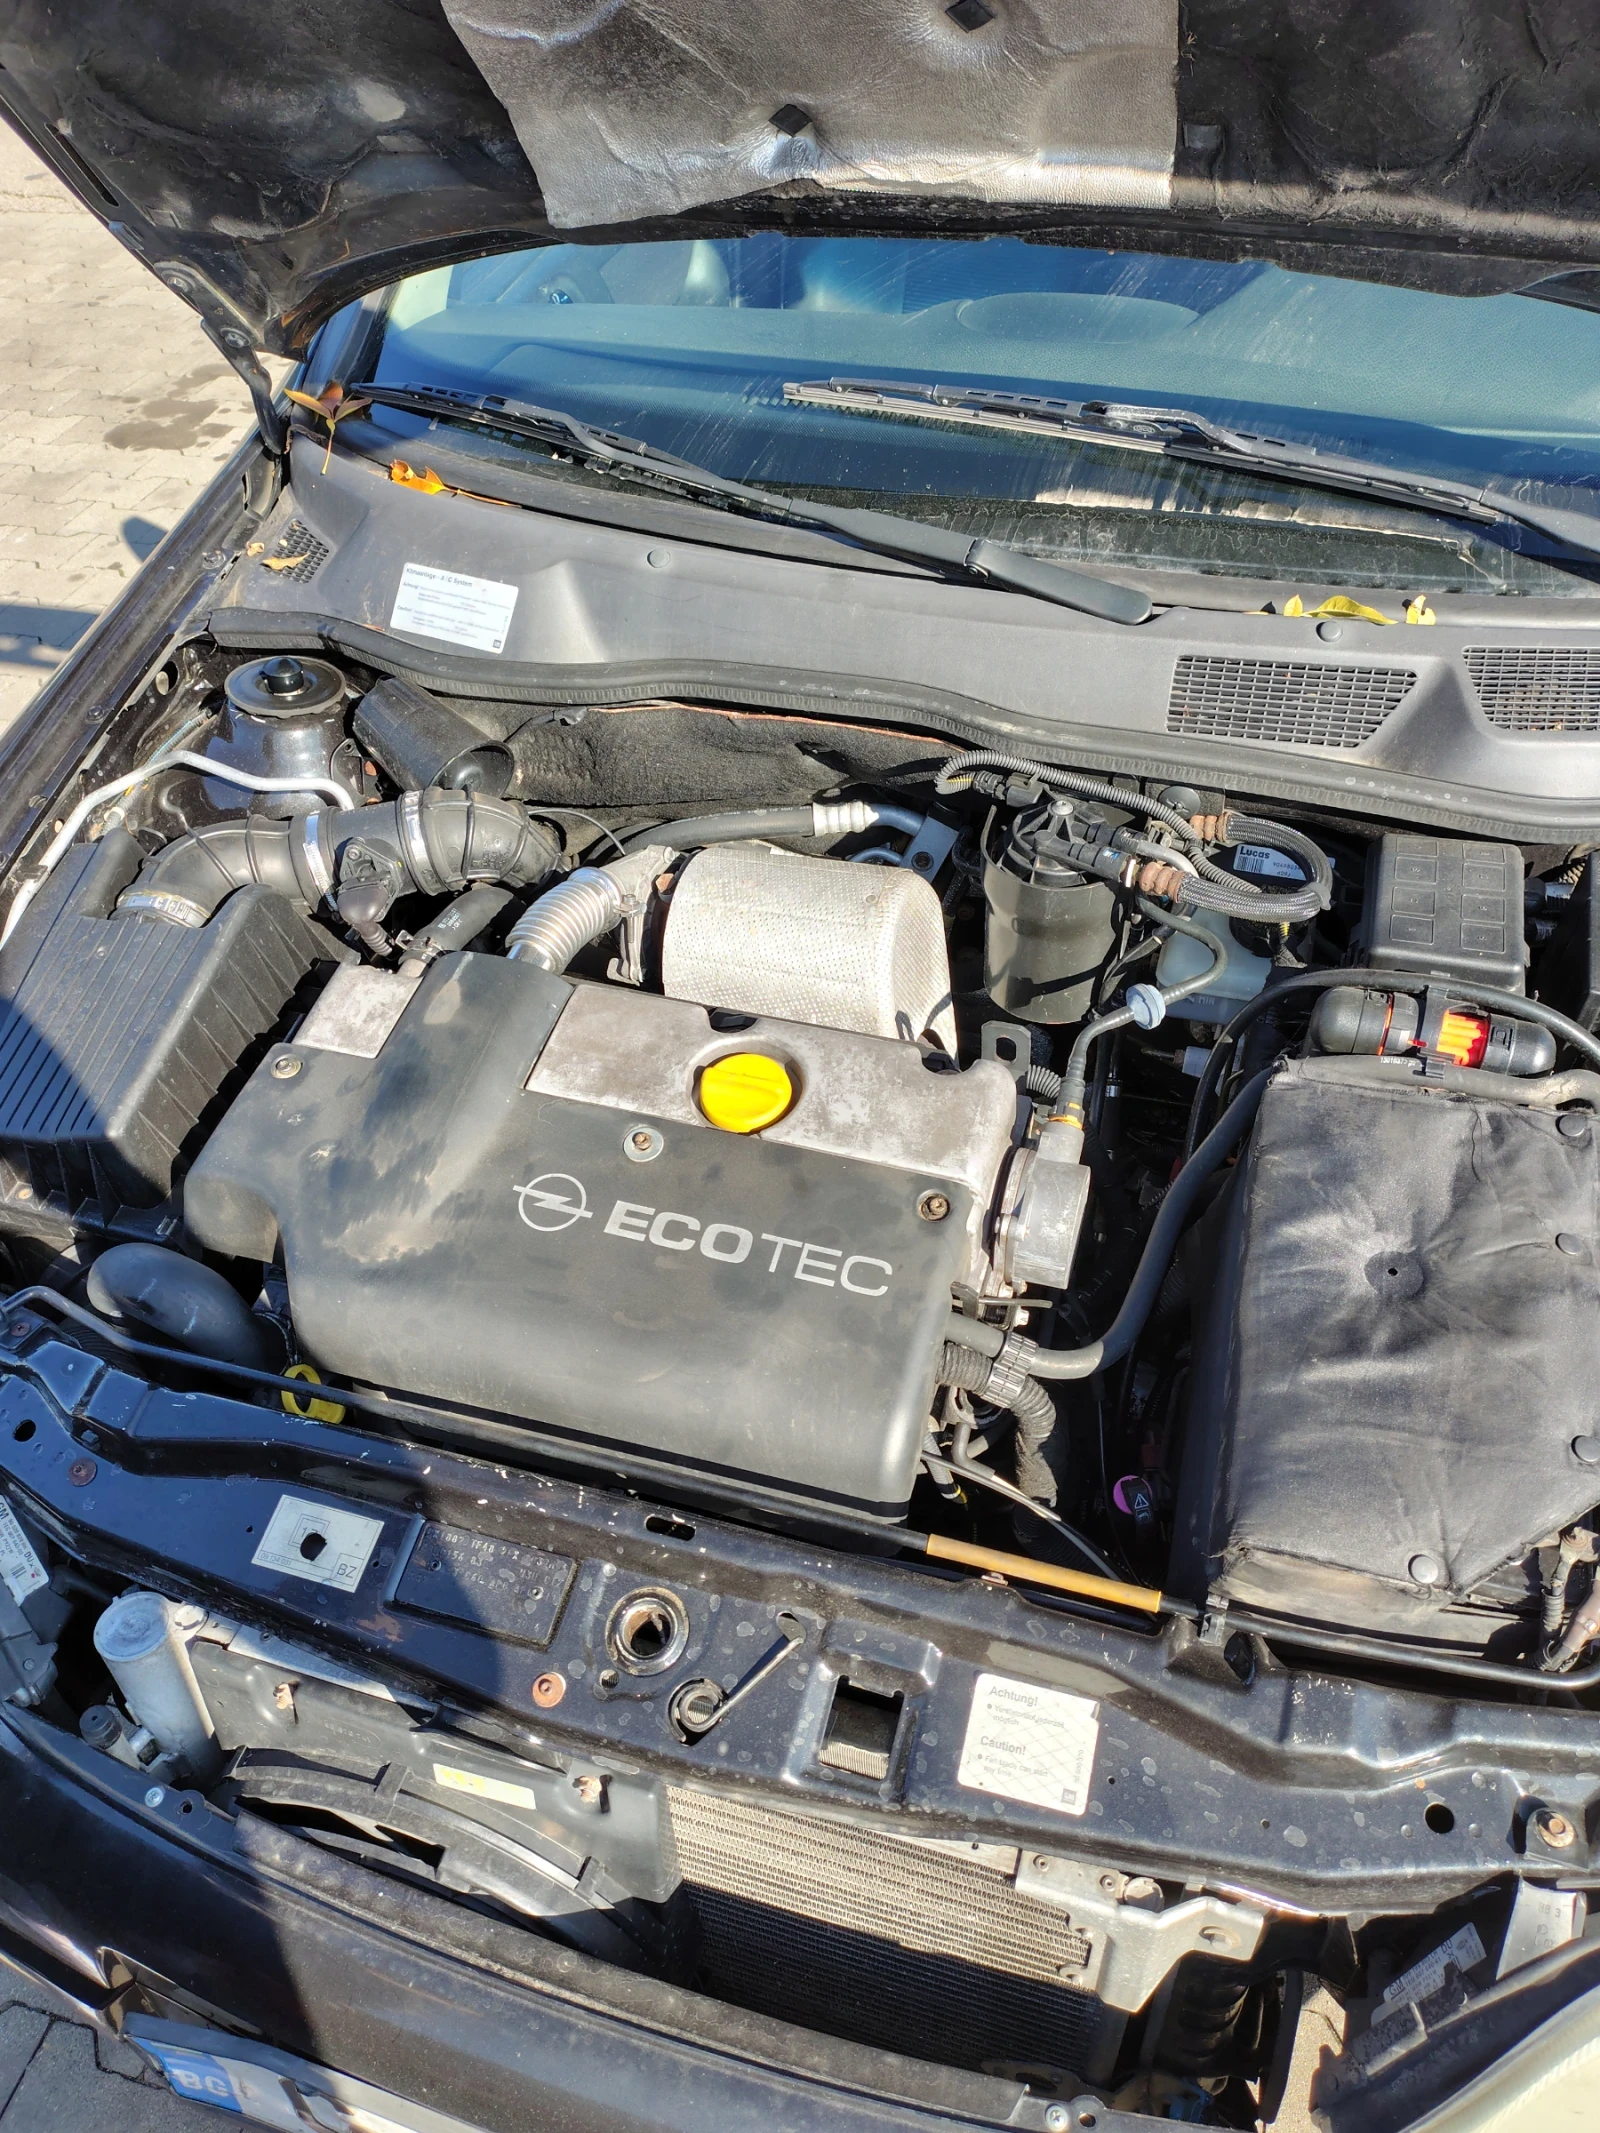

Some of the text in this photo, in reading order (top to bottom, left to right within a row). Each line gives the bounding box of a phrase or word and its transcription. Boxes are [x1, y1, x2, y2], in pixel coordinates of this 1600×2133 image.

[453, 577, 473, 587] System
[1239, 846, 1271, 859] Lucas
[1198, 994, 1216, 1006] MIN
[603, 1199, 893, 1297] ECOTEC
[336, 1563, 357, 1579] BZ
[989, 1686, 1039, 1707] Achtung!
[980, 1735, 1027, 1756] Caution!
[171, 2069, 229, 2097] BG
